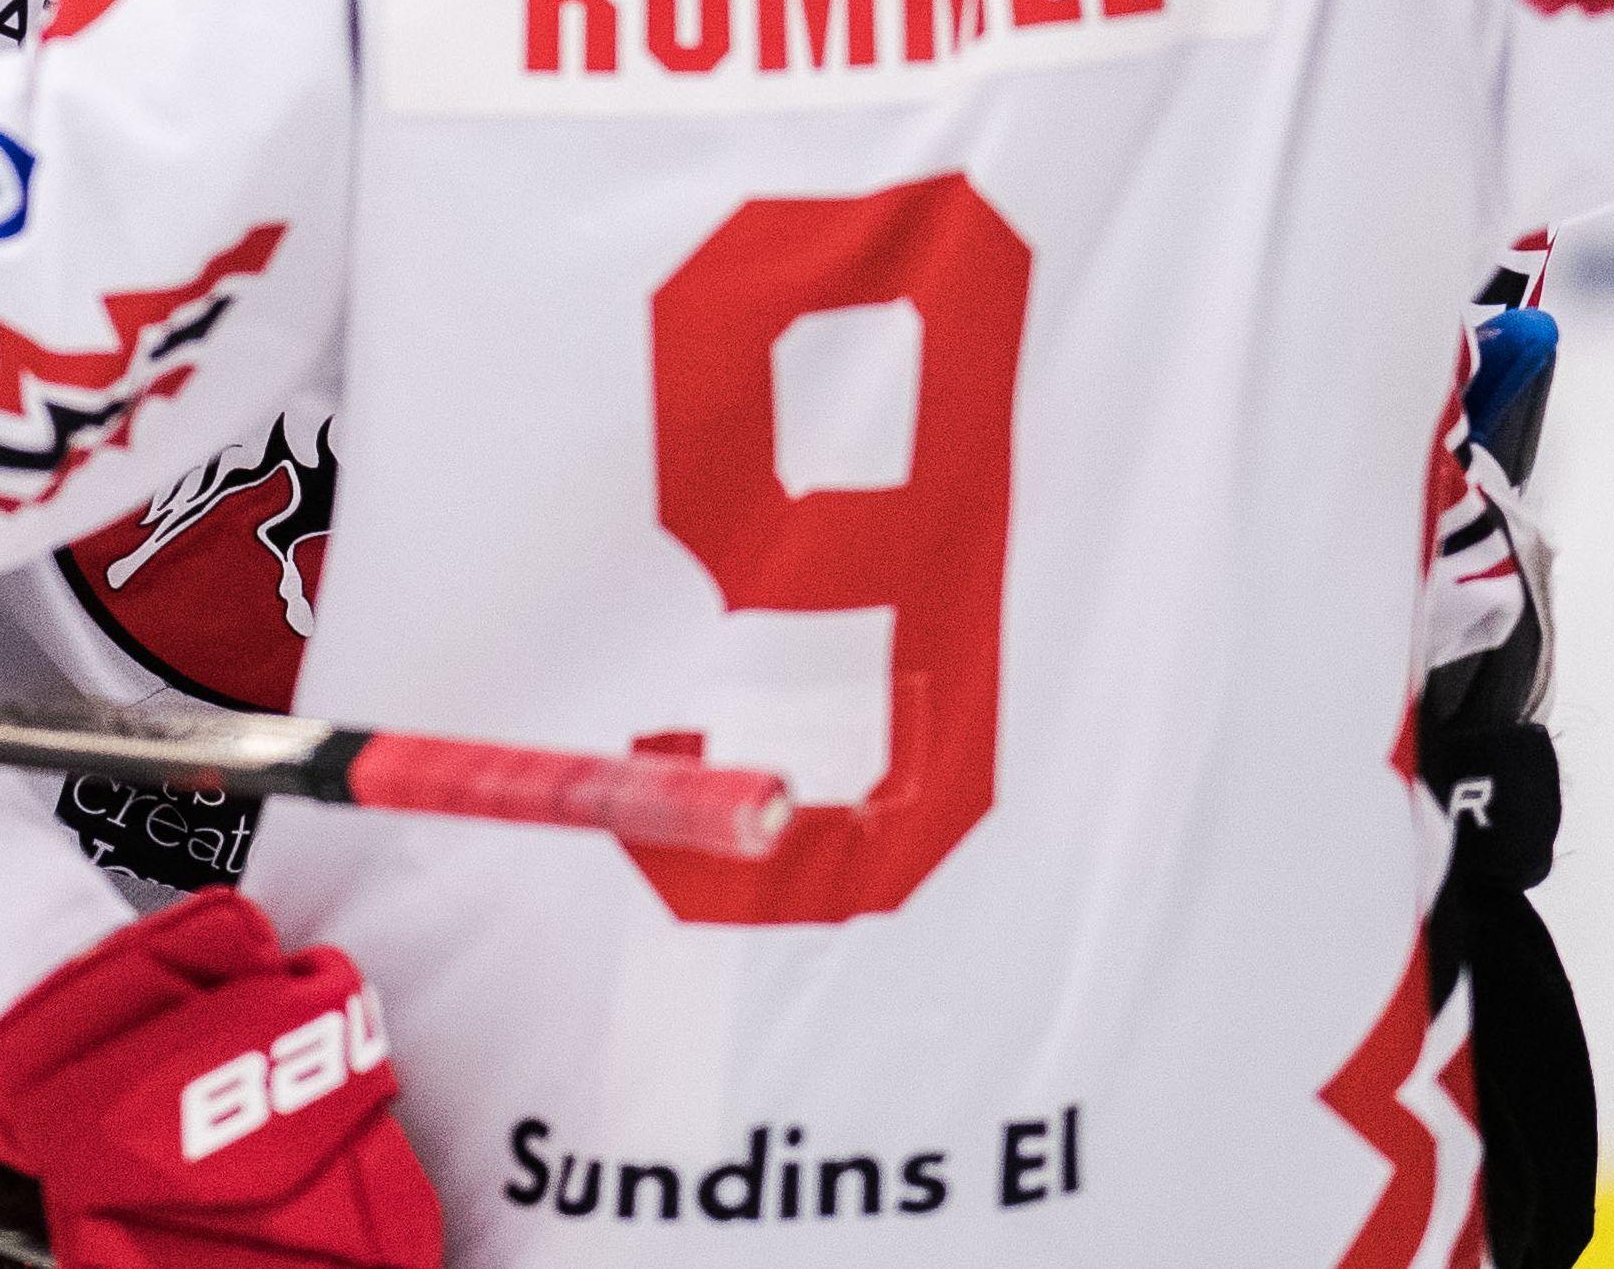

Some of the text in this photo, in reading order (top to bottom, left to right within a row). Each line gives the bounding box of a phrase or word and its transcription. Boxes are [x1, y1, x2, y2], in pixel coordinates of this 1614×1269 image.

[612, 171, 1035, 926] 9
[503, 1105, 1082, 1222] Sundins El
